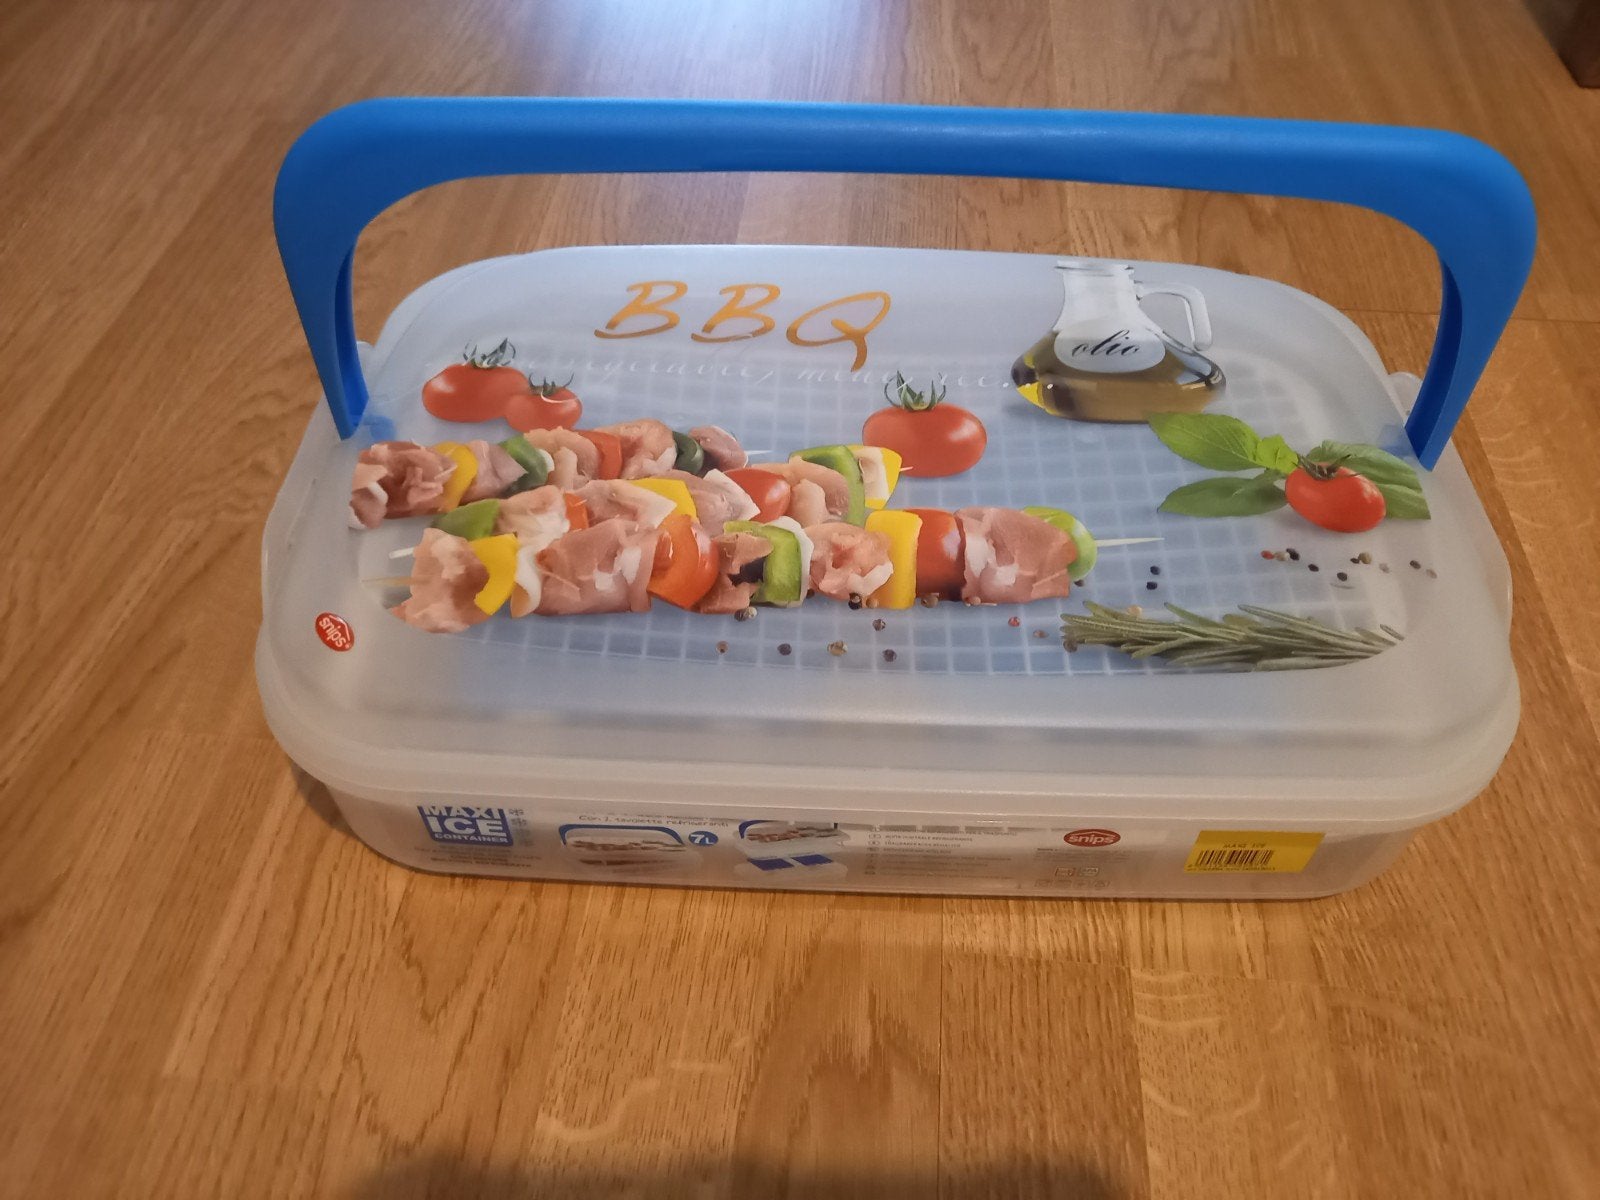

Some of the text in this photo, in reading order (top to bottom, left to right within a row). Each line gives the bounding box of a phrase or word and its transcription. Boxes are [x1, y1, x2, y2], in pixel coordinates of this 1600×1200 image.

[593, 280, 892, 373] BBQ
[1071, 329, 1141, 358] olio
[318, 616, 347, 648] snips
[420, 805, 502, 819] MAXI
[426, 816, 508, 838] ICE
[434, 833, 509, 844] CONTAINER
[1068, 834, 1115, 845] snips
